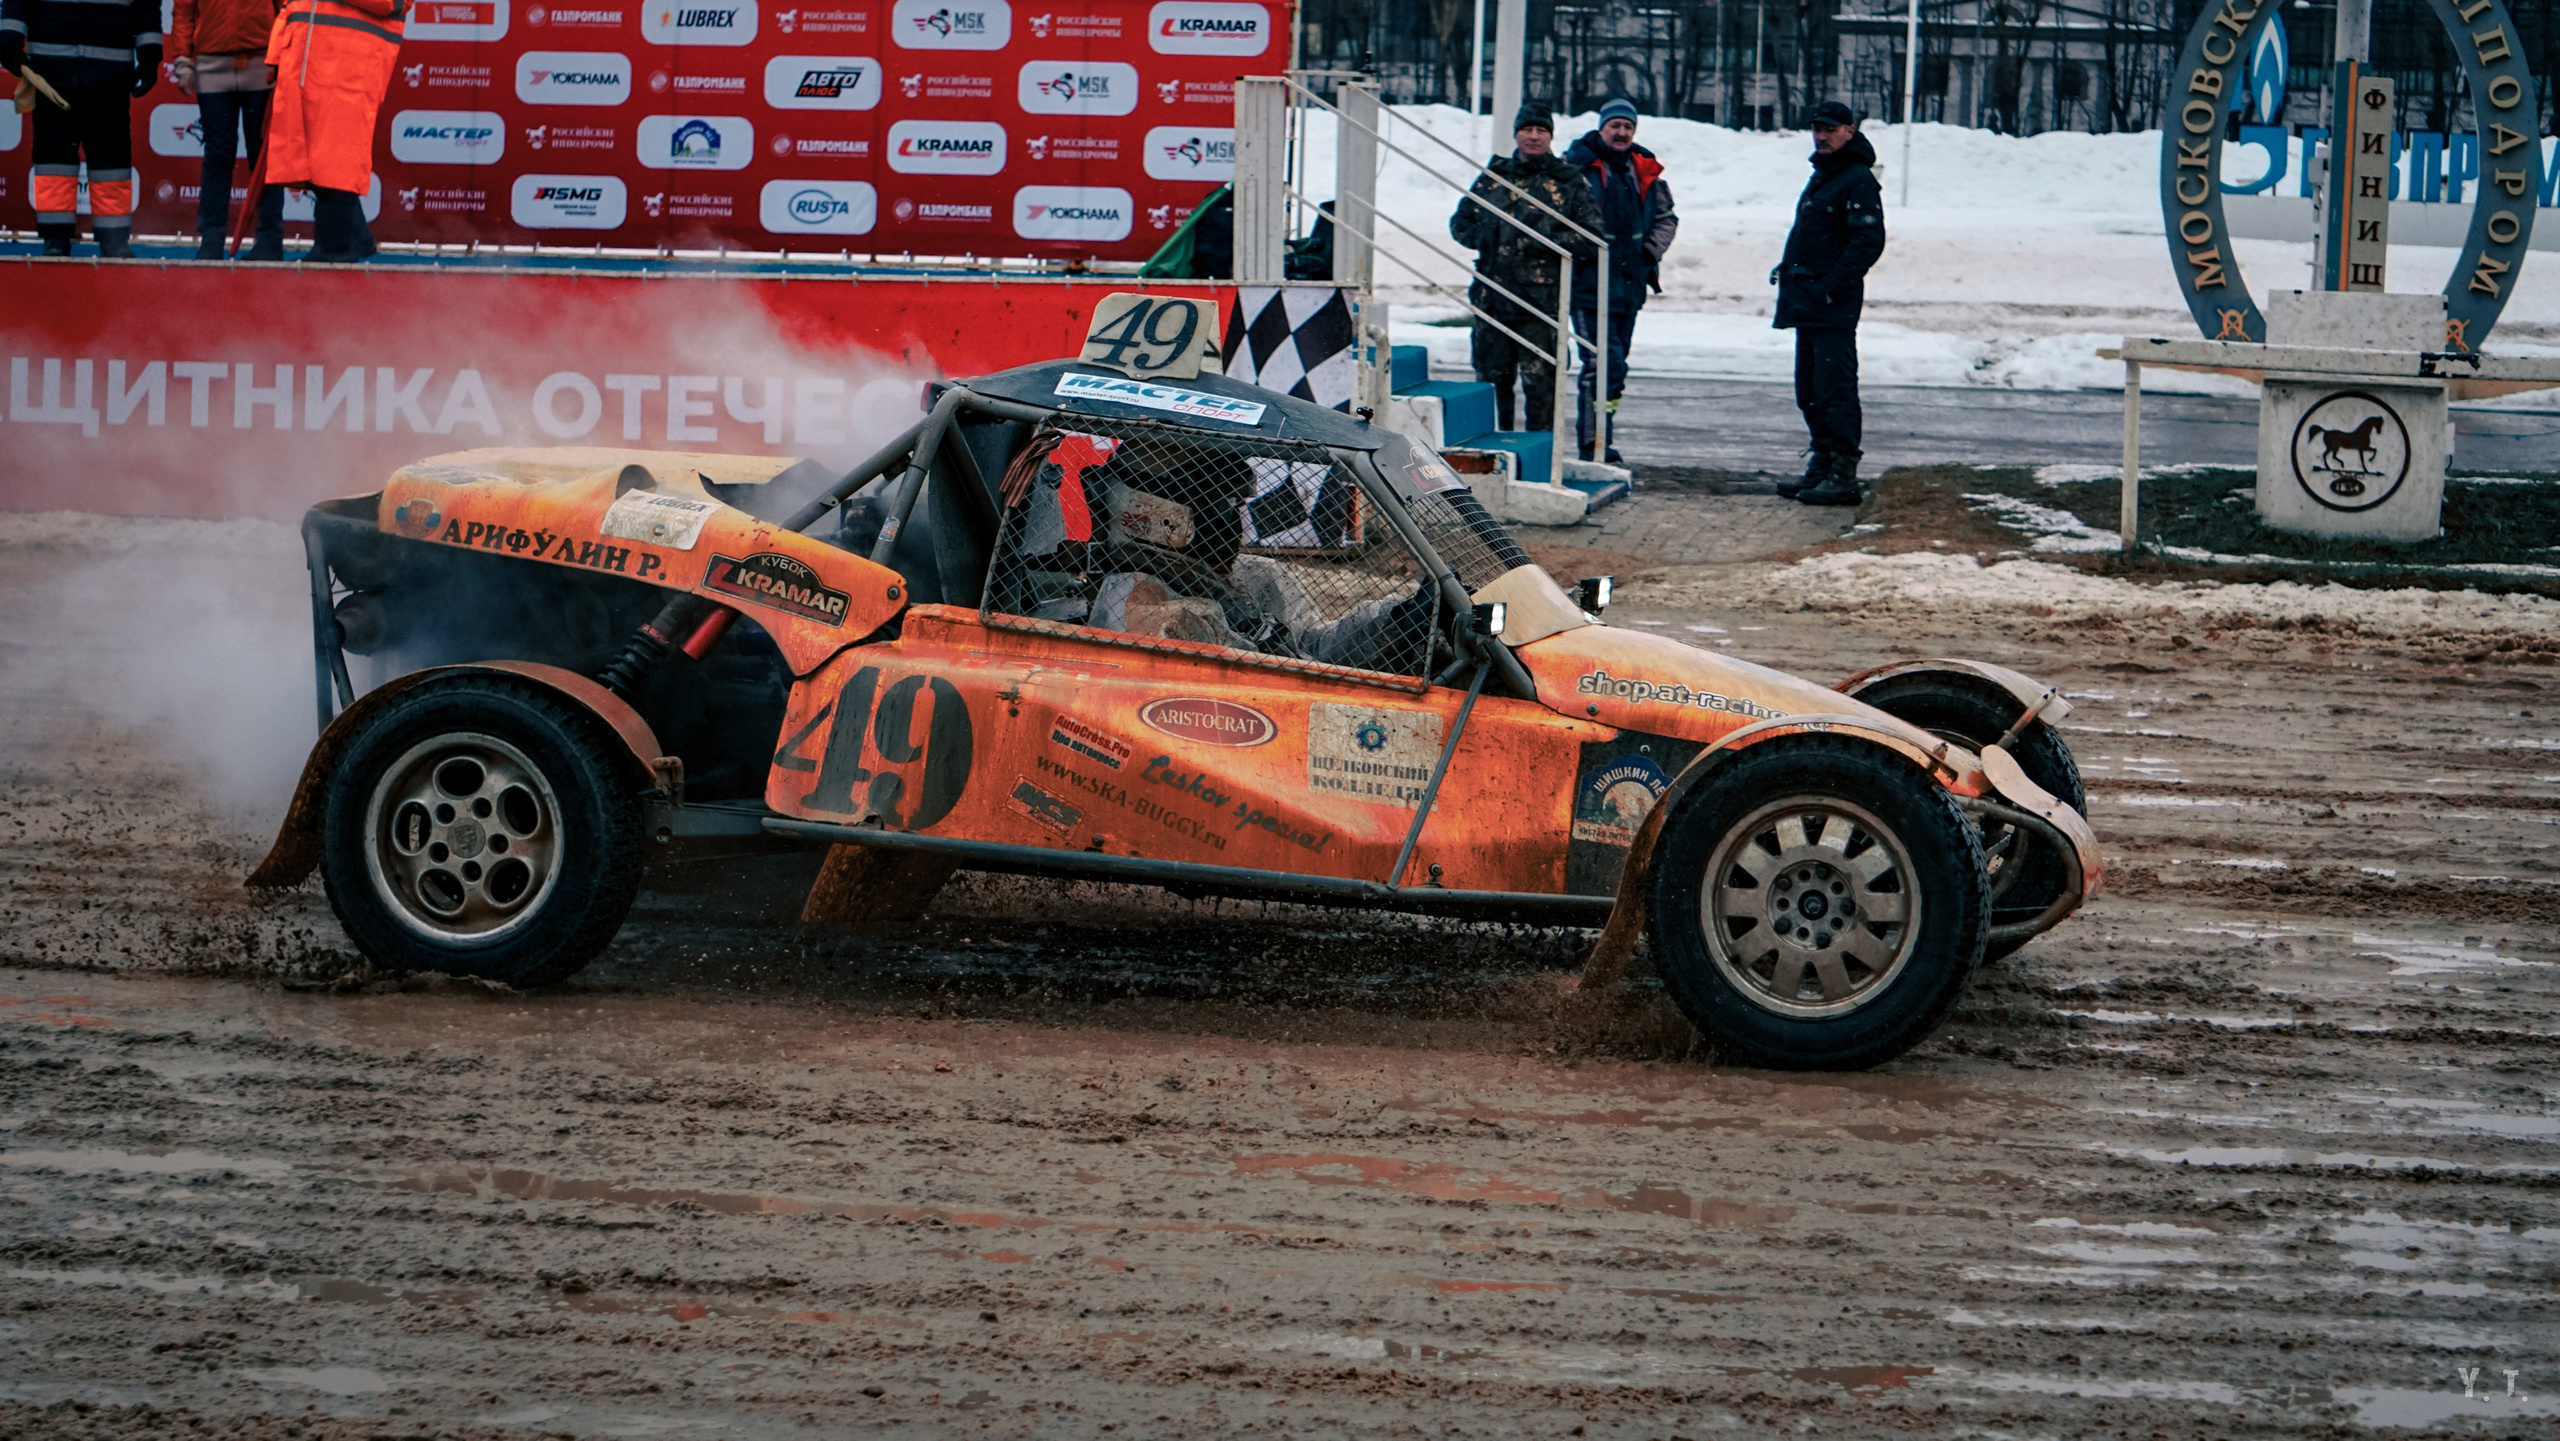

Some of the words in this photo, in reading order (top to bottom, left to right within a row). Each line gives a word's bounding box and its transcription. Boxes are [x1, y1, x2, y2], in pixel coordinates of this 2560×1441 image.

[551, 10, 622, 23] ГАЗПРОМБАНК
[677, 8, 740, 28] LUBREX
[954, 12, 985, 29] MSK
[1180, 19, 1257, 32] KRAMAR
[551, 72, 620, 85] YOKOHAMA
[673, 76, 746, 89] ГАЗПРОМБАНК
[803, 73, 857, 87] АВТО
[1078, 76, 1110, 93] MSK
[798, 87, 837, 96] ПЛЮС
[403, 126, 493, 139] МАСТЕР
[796, 140, 869, 153] ГАЗПРОМБАНК
[917, 139, 993, 152] KRAMAR
[2176, 0, 2265, 291] МОСКОВСК
[2350, 88, 2388, 287] ФИНИШ
[796, 200, 850, 215] RUSTA
[918, 204, 993, 218] ГАЗПРОМБАНК
[1049, 207, 1120, 221] YOKOHAMA
[1087, 298, 1199, 371] 49
[0, 356, 501, 438] ЩИТНИКА
[532, 370, 934, 446] ОТЕЧЕС
[1064, 375, 1260, 412] МАСТЕР
[1172, 404, 1246, 421] СПОРТ
[636, 552, 667, 581] Р.
[761, 556, 809, 579] КУБОК
[736, 568, 845, 616] KRAMAR
[1156, 708, 1258, 735] ARISTOCRAT
[1055, 714, 1131, 758] AutoCross.Pro
[773, 665, 973, 830] 49
[1051, 729, 1071, 747] Про
[1070, 740, 1121, 770] автокросс
[1593, 766, 1649, 793] ШИШКИН
[1649, 778, 1667, 796] ЛЕ
